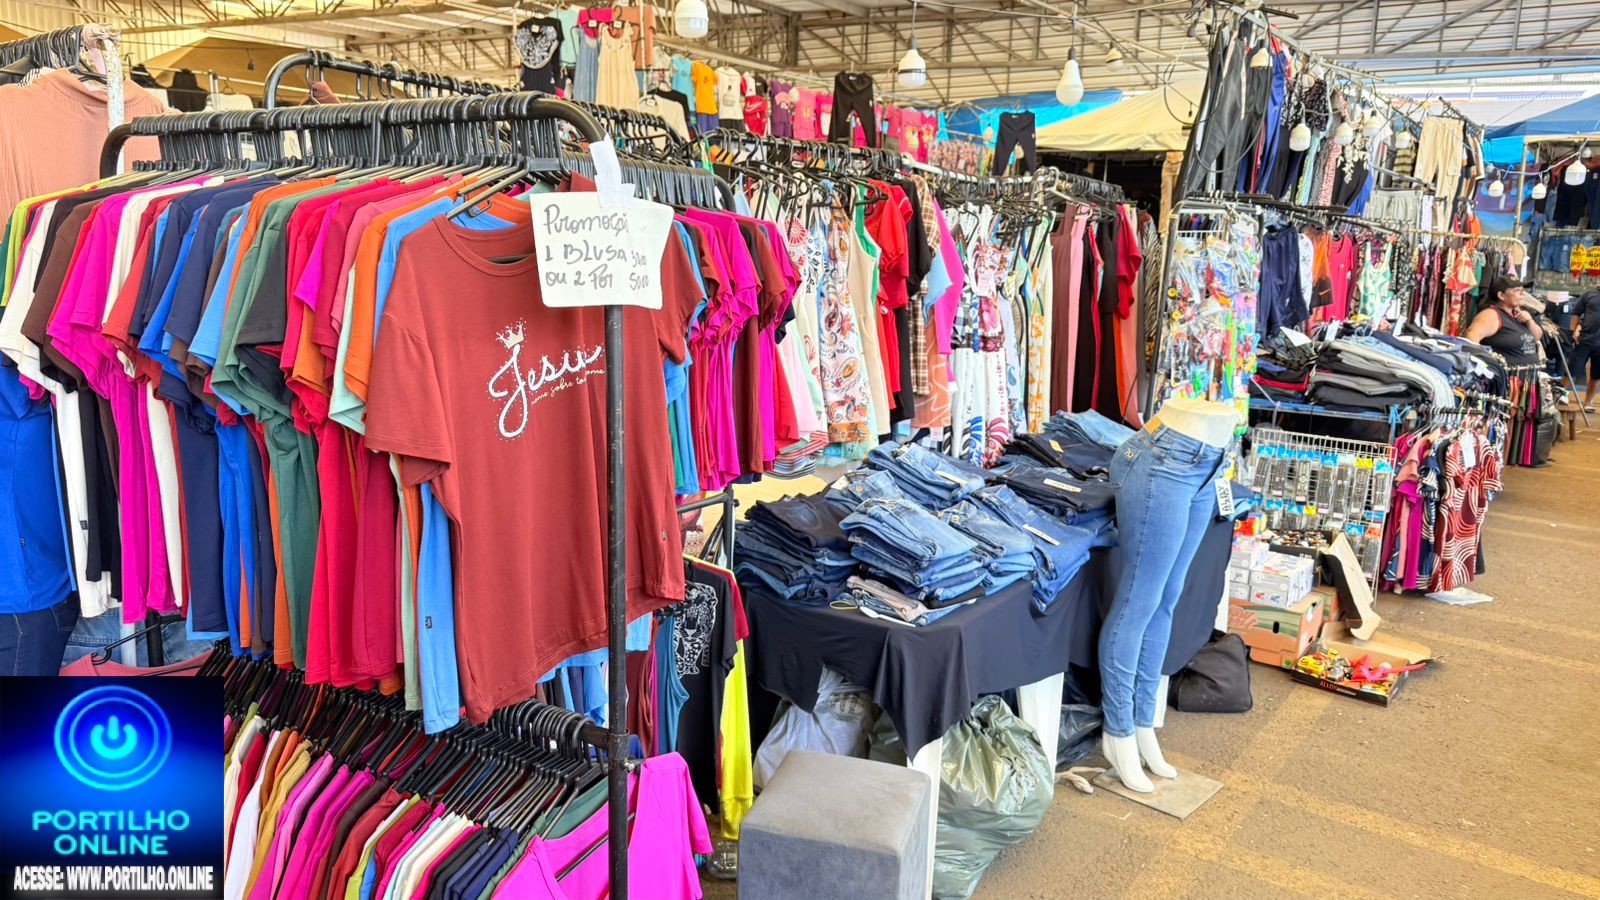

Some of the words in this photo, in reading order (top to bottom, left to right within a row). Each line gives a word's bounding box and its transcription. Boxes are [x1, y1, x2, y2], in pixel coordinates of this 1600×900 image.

[545, 245, 553, 262] 1
[563, 239, 627, 265] BLUSA
[573, 270, 586, 286] 2
[550, 378, 573, 398] sobre
